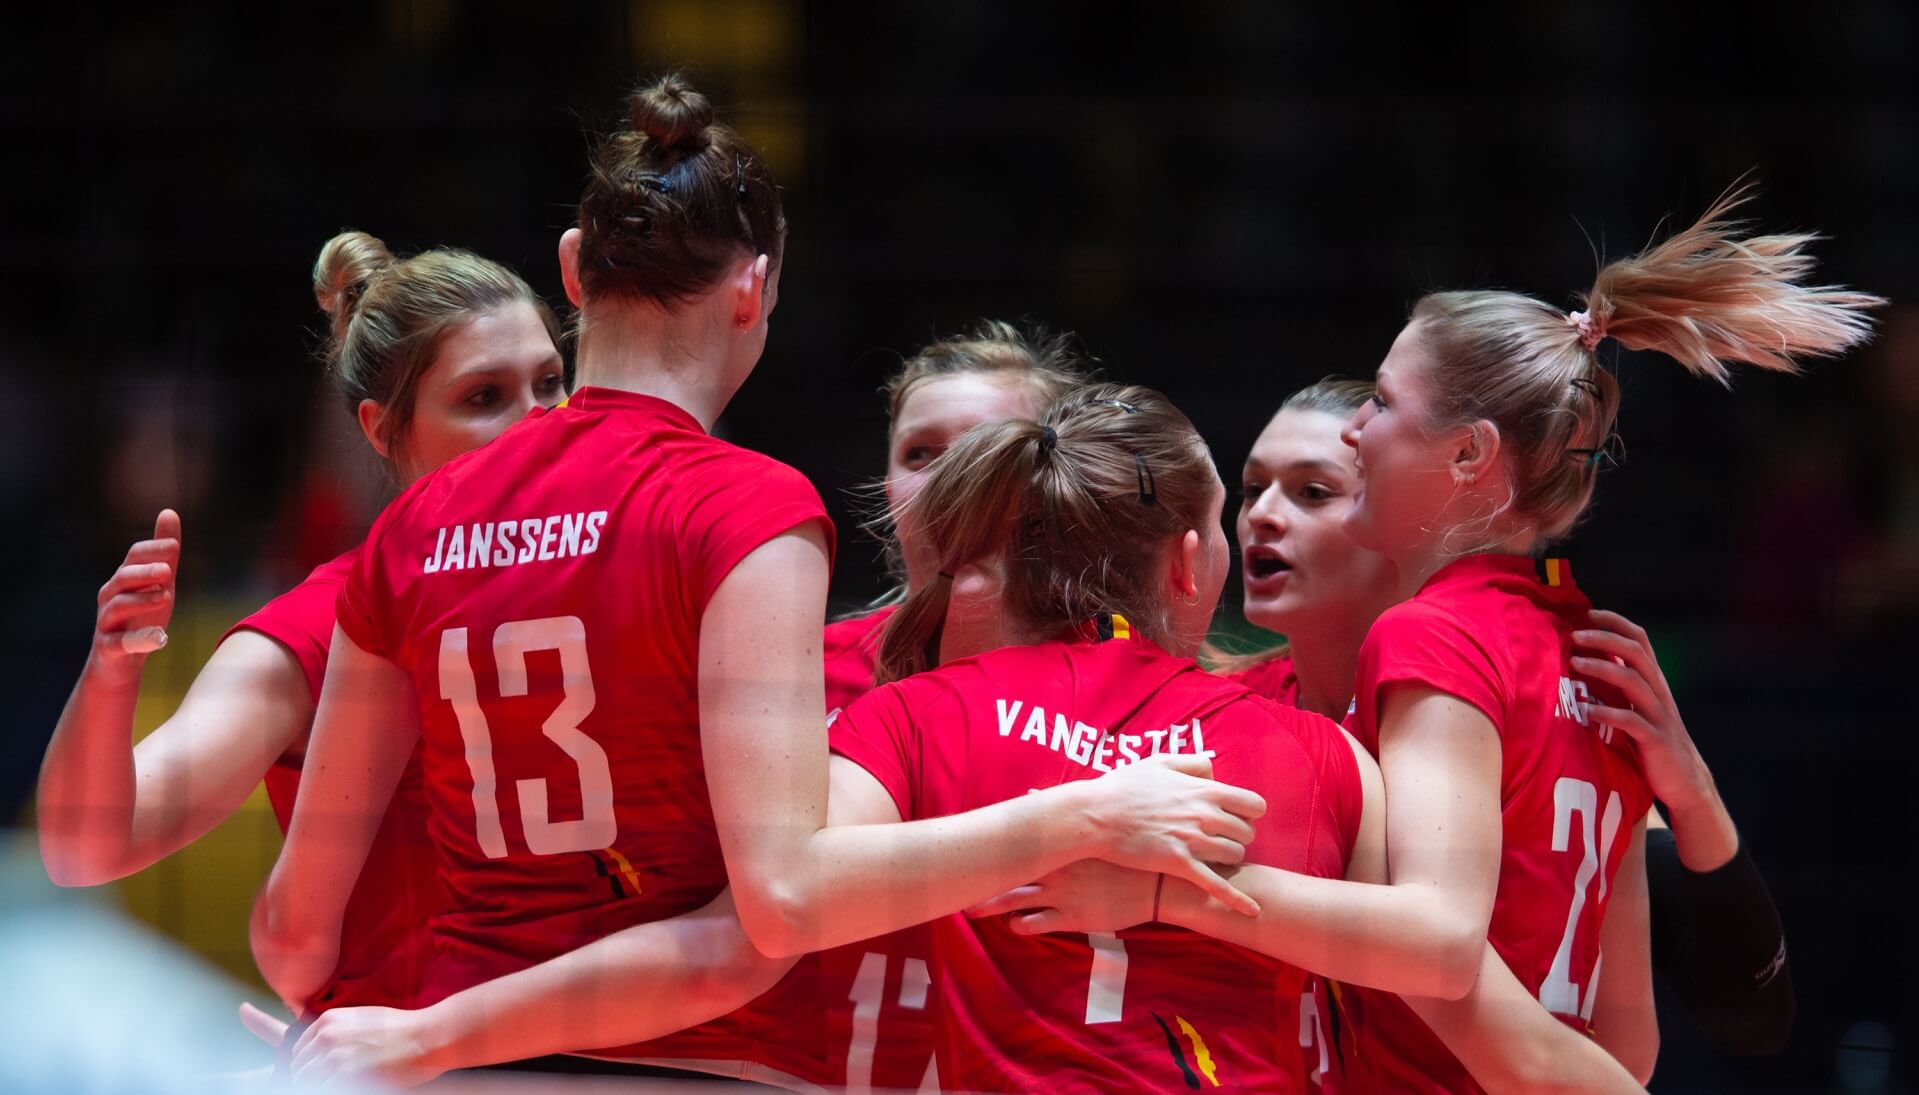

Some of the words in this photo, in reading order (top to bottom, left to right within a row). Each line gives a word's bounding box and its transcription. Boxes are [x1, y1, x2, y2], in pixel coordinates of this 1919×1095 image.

[424, 511, 608, 574] JANSSENS
[438, 615, 618, 859] 13
[996, 698, 1216, 772] VANGESTEL
